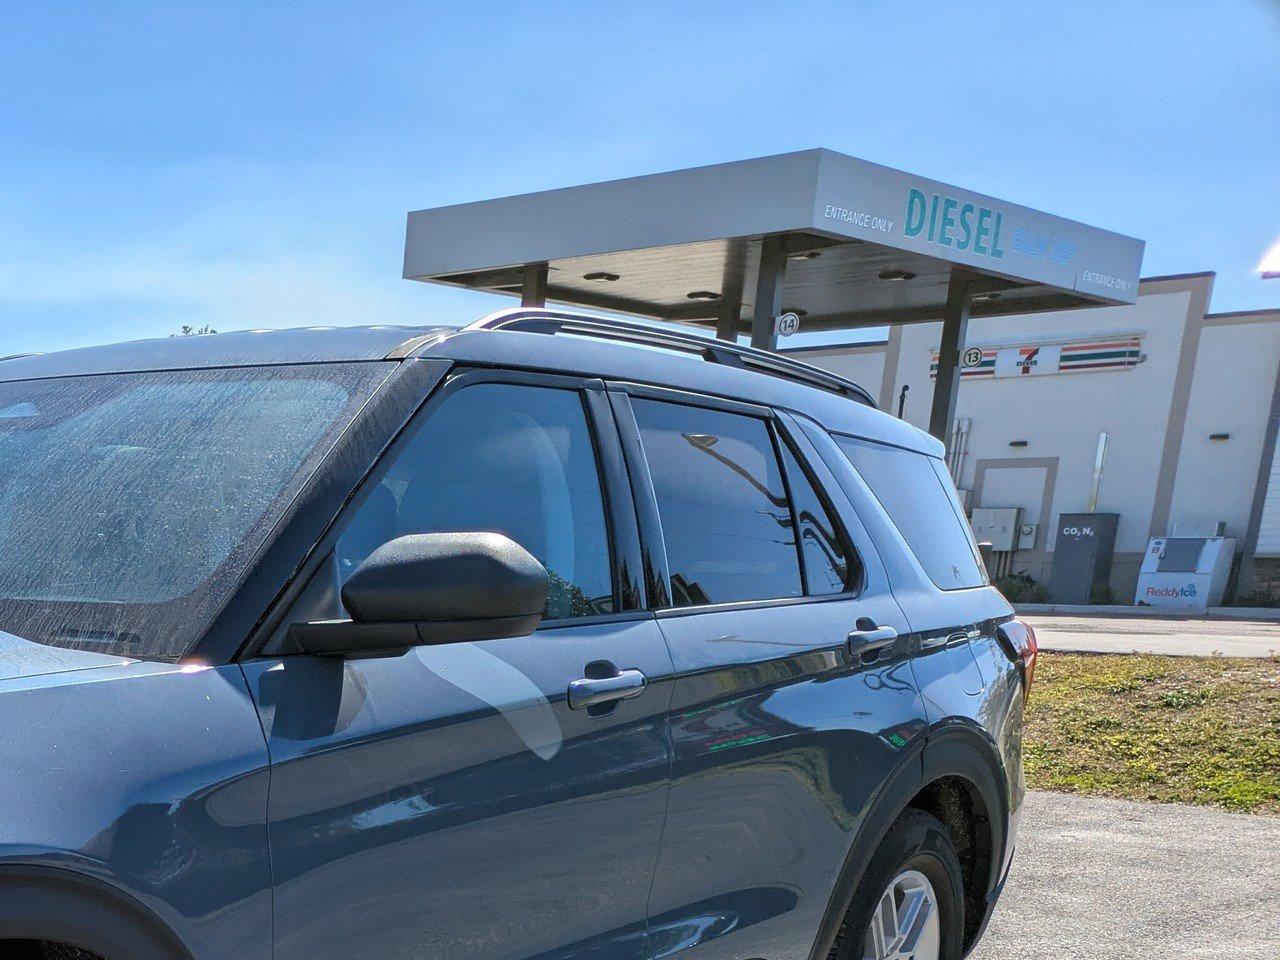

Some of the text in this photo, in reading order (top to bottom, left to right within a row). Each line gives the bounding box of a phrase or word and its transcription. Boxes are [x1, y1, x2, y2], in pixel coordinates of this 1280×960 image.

[824, 204, 894, 233] ENTRANCE ONLY
[903, 186, 1004, 260] DIESEL
[782, 318, 795, 331] 14
[967, 351, 979, 363] 13
[1019, 347, 1039, 374] 7
